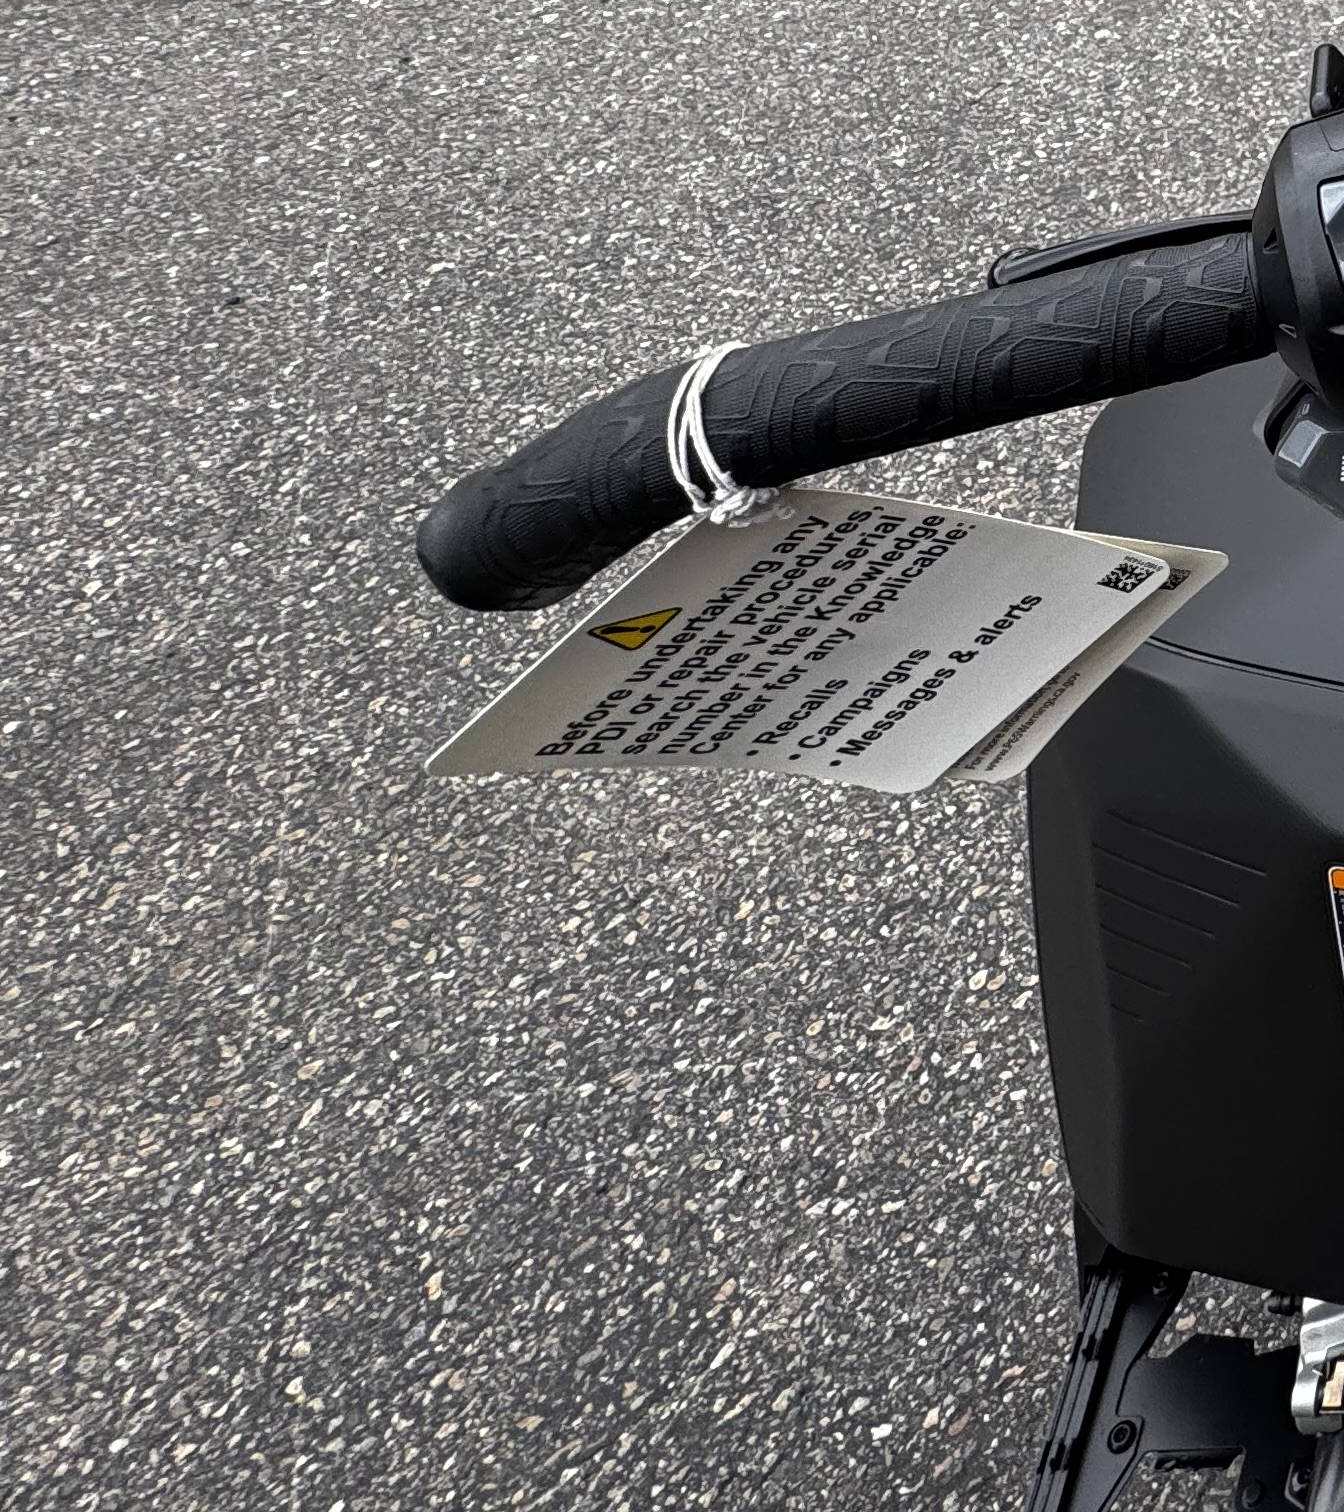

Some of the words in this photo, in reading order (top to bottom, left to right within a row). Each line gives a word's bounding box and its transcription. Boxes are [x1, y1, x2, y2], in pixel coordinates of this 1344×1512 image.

[536, 689, 631, 756] Before
[627, 560, 782, 682] undertaking
[772, 516, 828, 553] any
[575, 721, 635, 754] PDI
[629, 693, 663, 714] or
[657, 630, 733, 688] repair
[731, 506, 883, 624] procedures,
[621, 689, 708, 754] search
[697, 652, 749, 682] the
[743, 576, 835, 646] vehicle
[831, 515, 905, 570] serial
[658, 683, 749, 754] number
[738, 661, 778, 678] in
[767, 626, 817, 655] the
[806, 515, 943, 620] Knowledge
[689, 695, 771, 754] Center
[762, 664, 807, 690] for
[803, 627, 855, 661] any
[849, 523, 973, 622] applicable:
[753, 679, 847, 744] Recalls
[798, 649, 929, 748] Campaigns
[837, 668, 954, 755] Messages
[948, 650, 978, 663] &
[974, 595, 1041, 645] alerts
